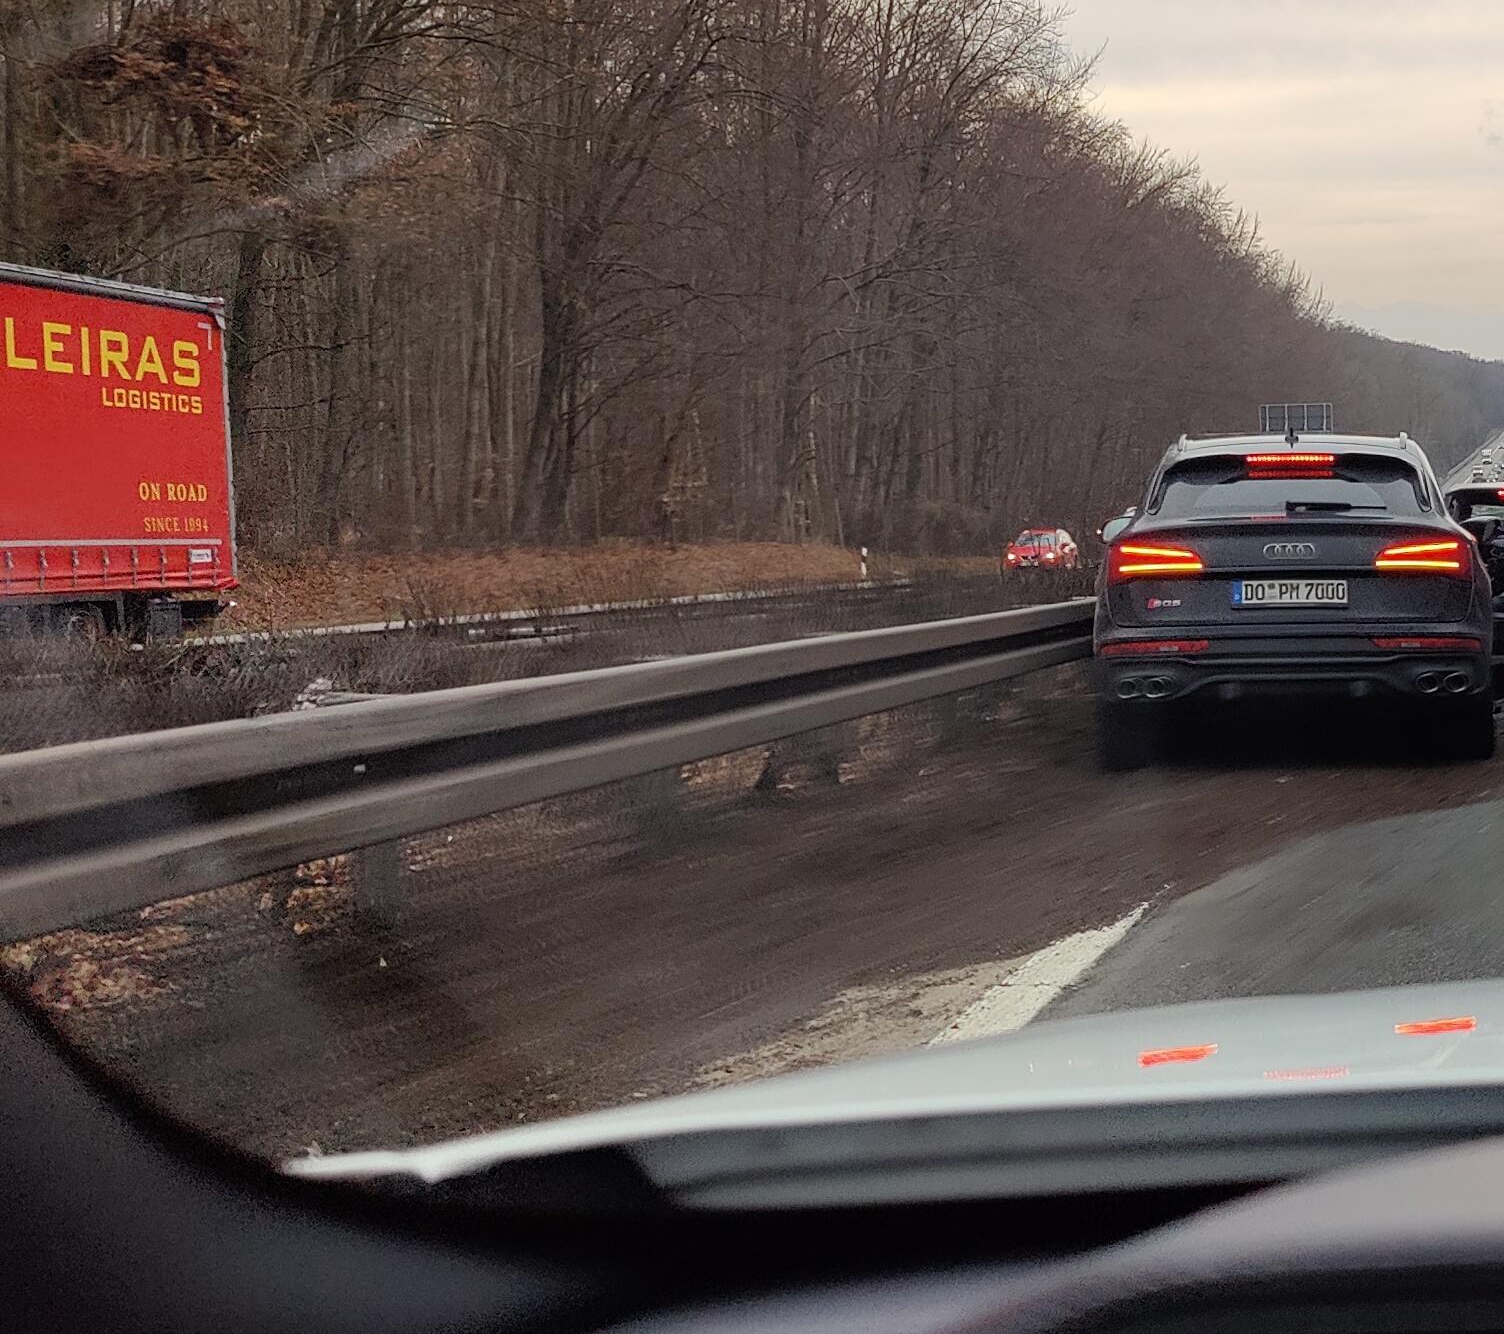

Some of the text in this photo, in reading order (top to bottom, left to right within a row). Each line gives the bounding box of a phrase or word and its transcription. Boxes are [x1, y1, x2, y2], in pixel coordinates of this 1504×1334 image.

[5, 316, 201, 387] LEIRAS
[101, 387, 203, 415] LOGISTICS
[139, 482, 208, 502] ON ROAD
[144, 516, 181, 533] SINCE
[1244, 582, 1345, 601] DO PM 7000
